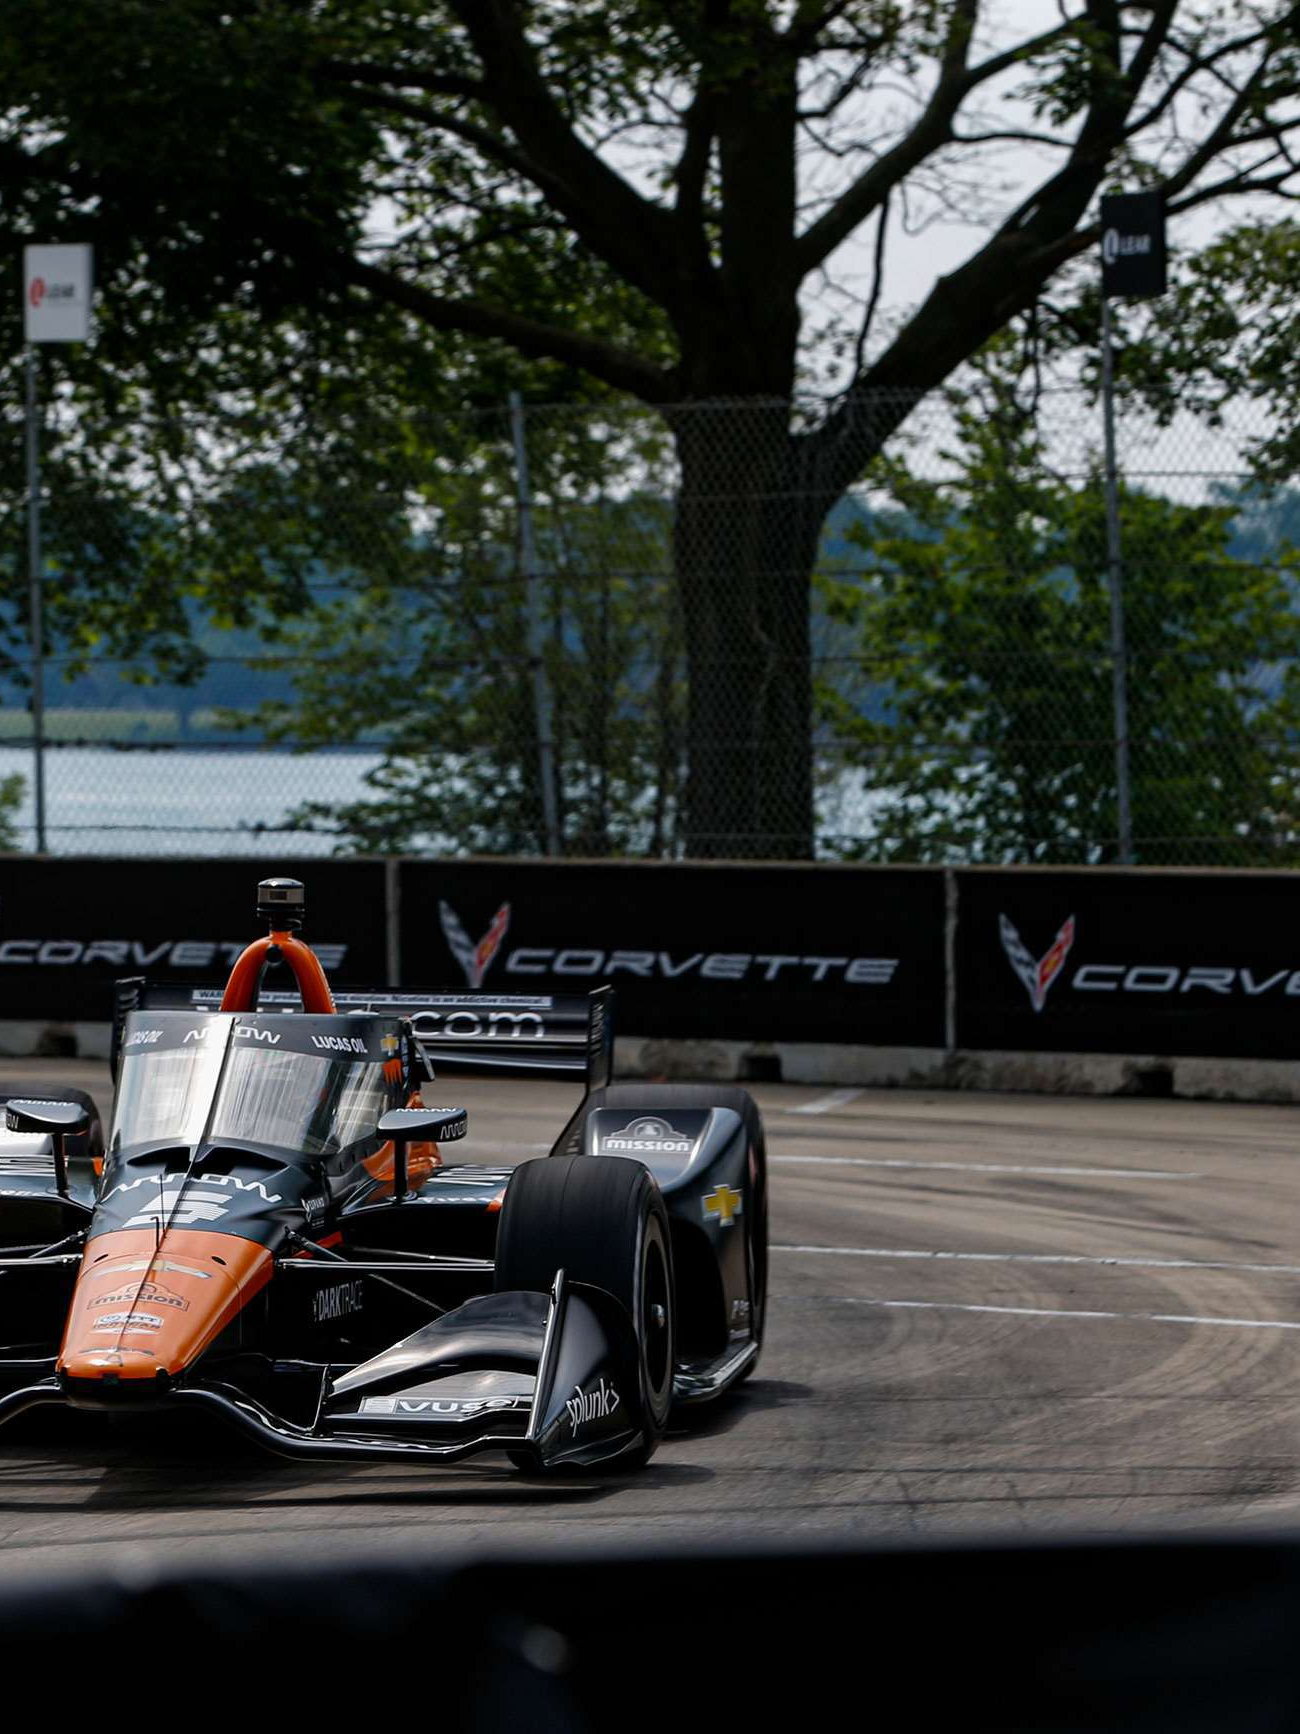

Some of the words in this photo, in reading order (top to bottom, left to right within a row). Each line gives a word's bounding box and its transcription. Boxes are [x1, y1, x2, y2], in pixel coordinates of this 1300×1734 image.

[505, 947, 900, 984] CORVETTE
[1072, 964, 1300, 995] CORV
[411, 1010, 546, 1038] com
[311, 1035, 353, 1053] LUCAS
[350, 1037, 369, 1053] OIL
[606, 1138, 690, 1152] mission
[121, 1189, 235, 1229] 5
[94, 1293, 184, 1308] mission
[317, 1279, 365, 1322] DARKTRACE
[399, 1397, 513, 1413] vuse
